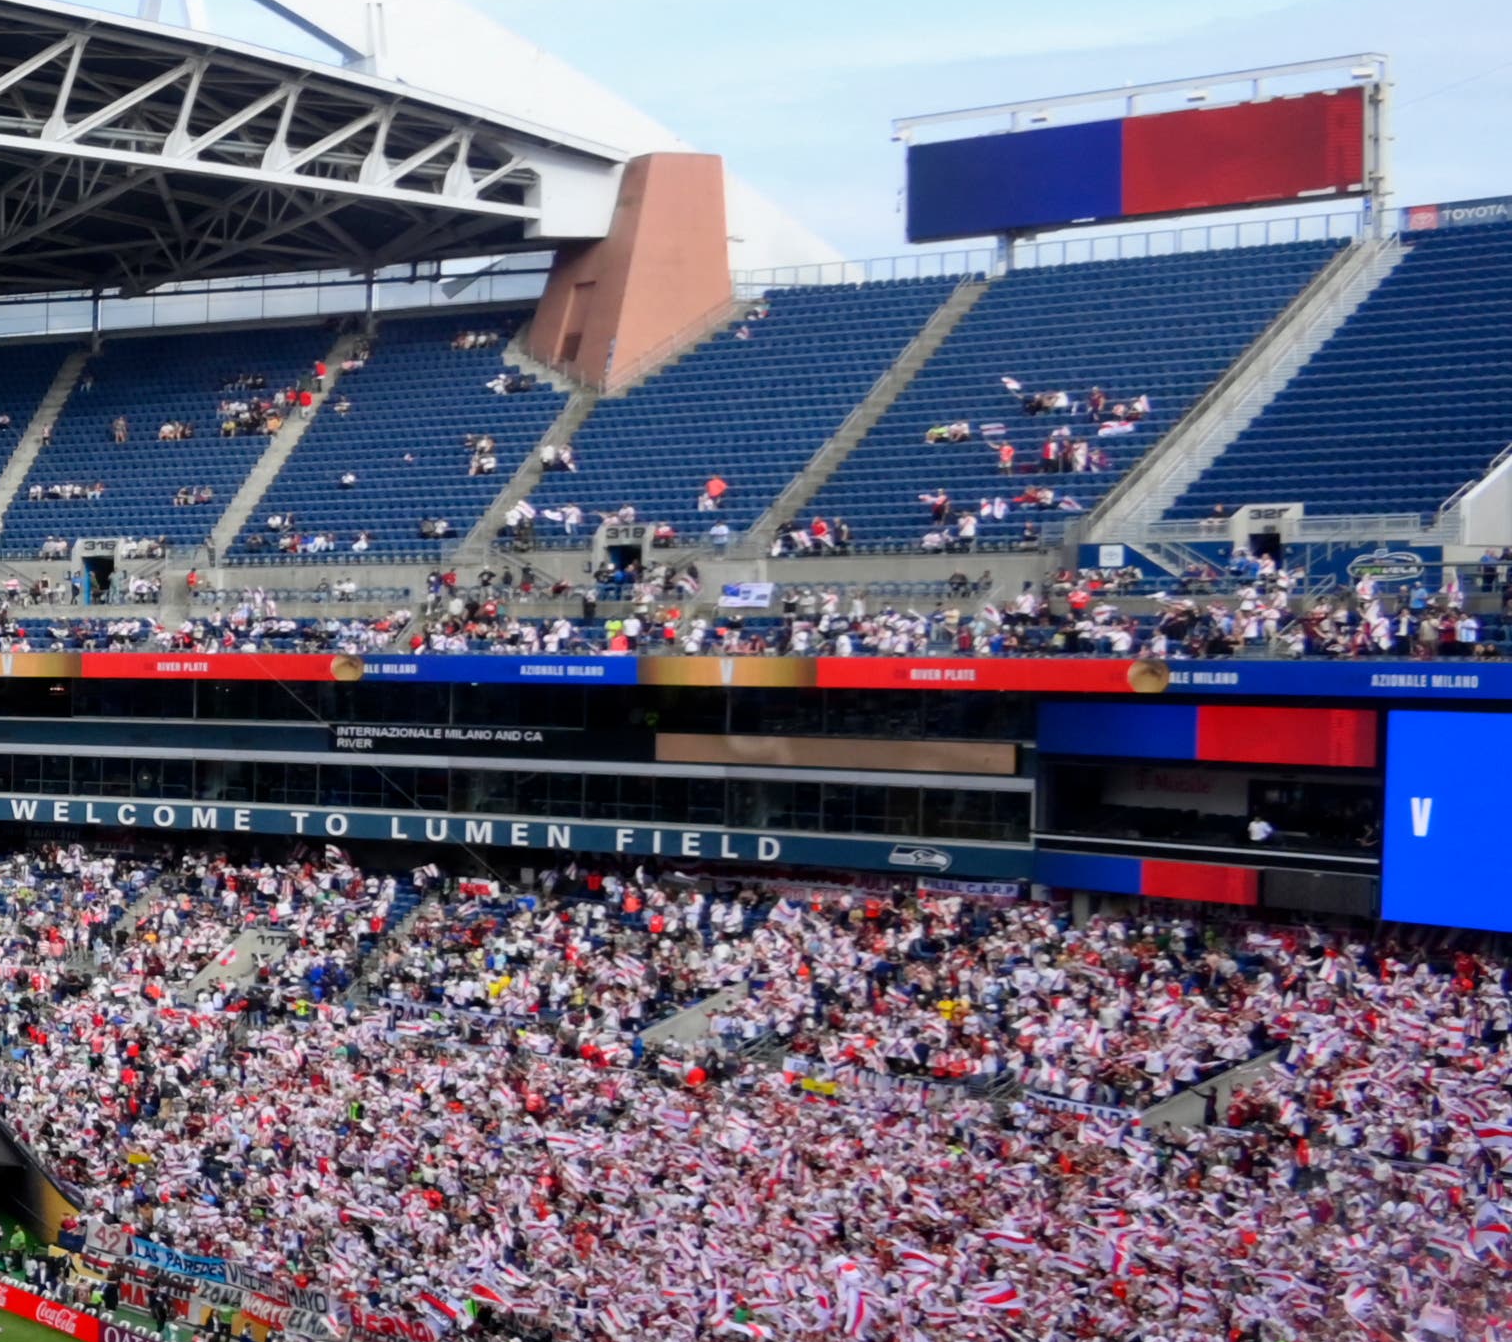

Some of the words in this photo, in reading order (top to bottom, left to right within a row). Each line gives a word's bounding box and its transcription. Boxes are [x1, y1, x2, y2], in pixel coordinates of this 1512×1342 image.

[1441, 204, 1509, 224] TOYOTA
[84, 540, 117, 550] 316
[720, 658, 734, 684] V
[910, 669, 942, 680] RIVER
[944, 669, 975, 681] PLATE
[336, 725, 442, 739] INTERNAZIONALE
[444, 728, 492, 741] MILANO
[494, 731, 522, 742] AND
[523, 732, 544, 743] CA
[336, 737, 373, 749] RIVER
[1410, 796, 1434, 838] V
[10, 798, 251, 831] WELCOME
[290, 811, 348, 836] TO
[391, 816, 570, 849] LUMEN
[615, 827, 781, 862] FIELD
[94, 1226, 121, 1251] 42
[134, 1244, 160, 1263] LAS
[167, 1252, 227, 1279] PAREDES
[34, 1299, 78, 1336] Coca-Cola
